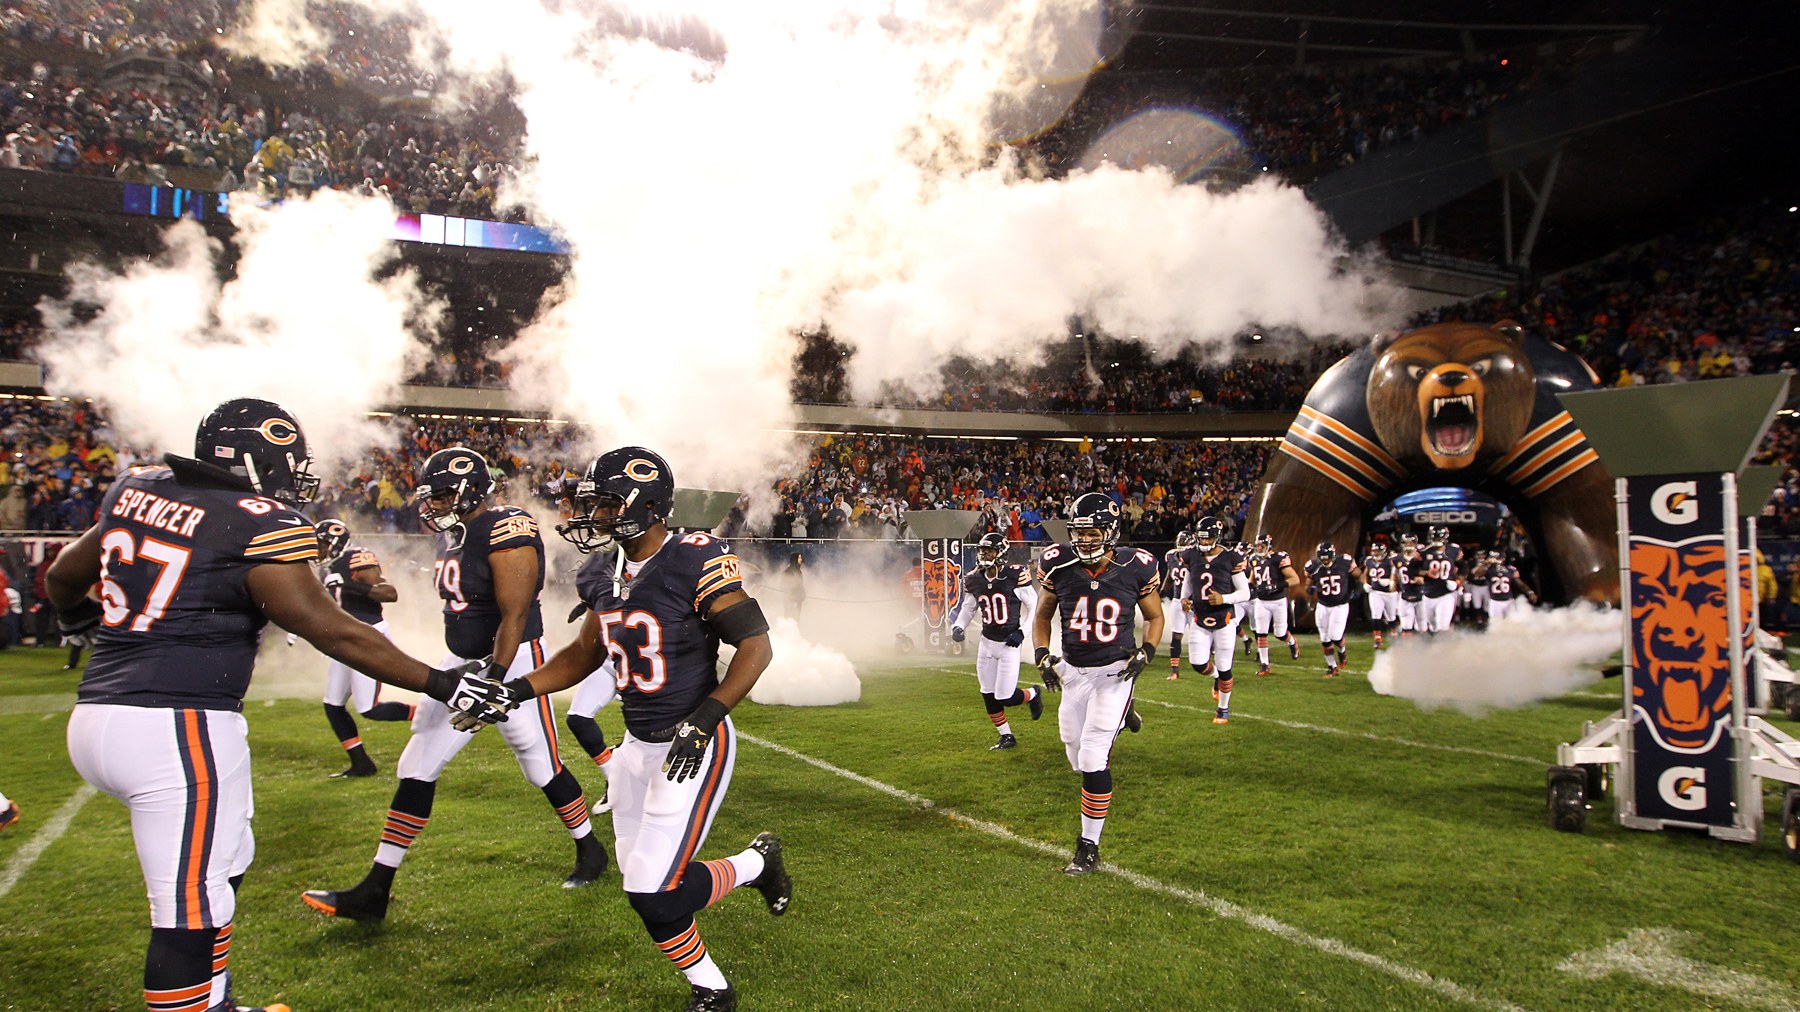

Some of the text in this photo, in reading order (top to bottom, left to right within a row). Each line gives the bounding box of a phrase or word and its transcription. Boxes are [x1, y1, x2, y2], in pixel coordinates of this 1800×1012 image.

[112, 488, 205, 538] SPENCER
[1650, 481, 1699, 525] G
[508, 520, 531, 534] GSH
[1413, 511, 1477, 523] GEICO
[928, 540, 939, 555] G
[951, 540, 960, 555] G
[1135, 548, 1154, 565] 4
[101, 528, 192, 632] 67
[434, 559, 469, 612] 79
[1200, 572, 1214, 600] 2
[1254, 566, 1272, 586] 54
[1320, 575, 1341, 596] 55
[1491, 576, 1511, 594] 26
[978, 592, 1008, 626] 30
[1069, 596, 1122, 644] 48
[929, 632, 940, 646] G
[599, 609, 667, 694] 53
[1658, 766, 1707, 811] G
